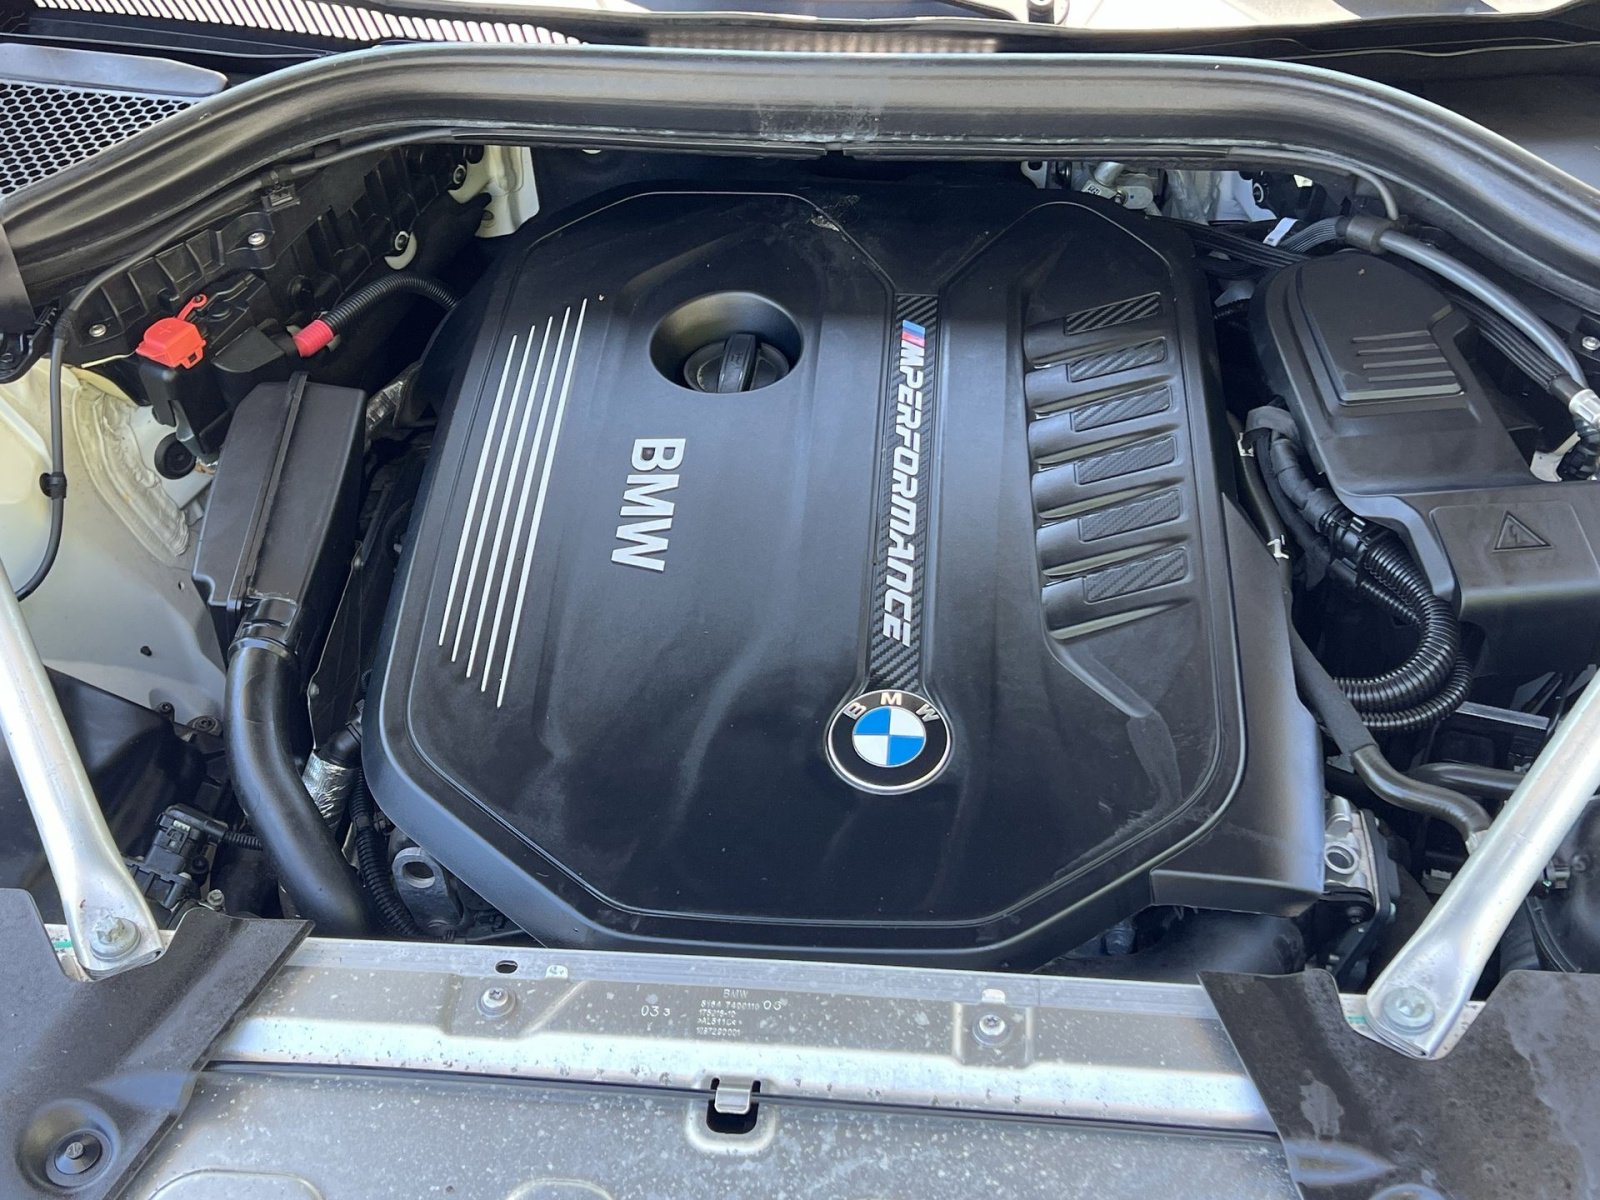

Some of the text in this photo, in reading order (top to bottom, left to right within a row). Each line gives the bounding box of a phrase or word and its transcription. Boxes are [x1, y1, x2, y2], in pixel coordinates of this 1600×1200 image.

[611, 438, 687, 572] BMW
[883, 366, 923, 648] PERFORMANCE
[842, 692, 940, 722] BMW
[723, 988, 749, 999] BMW
